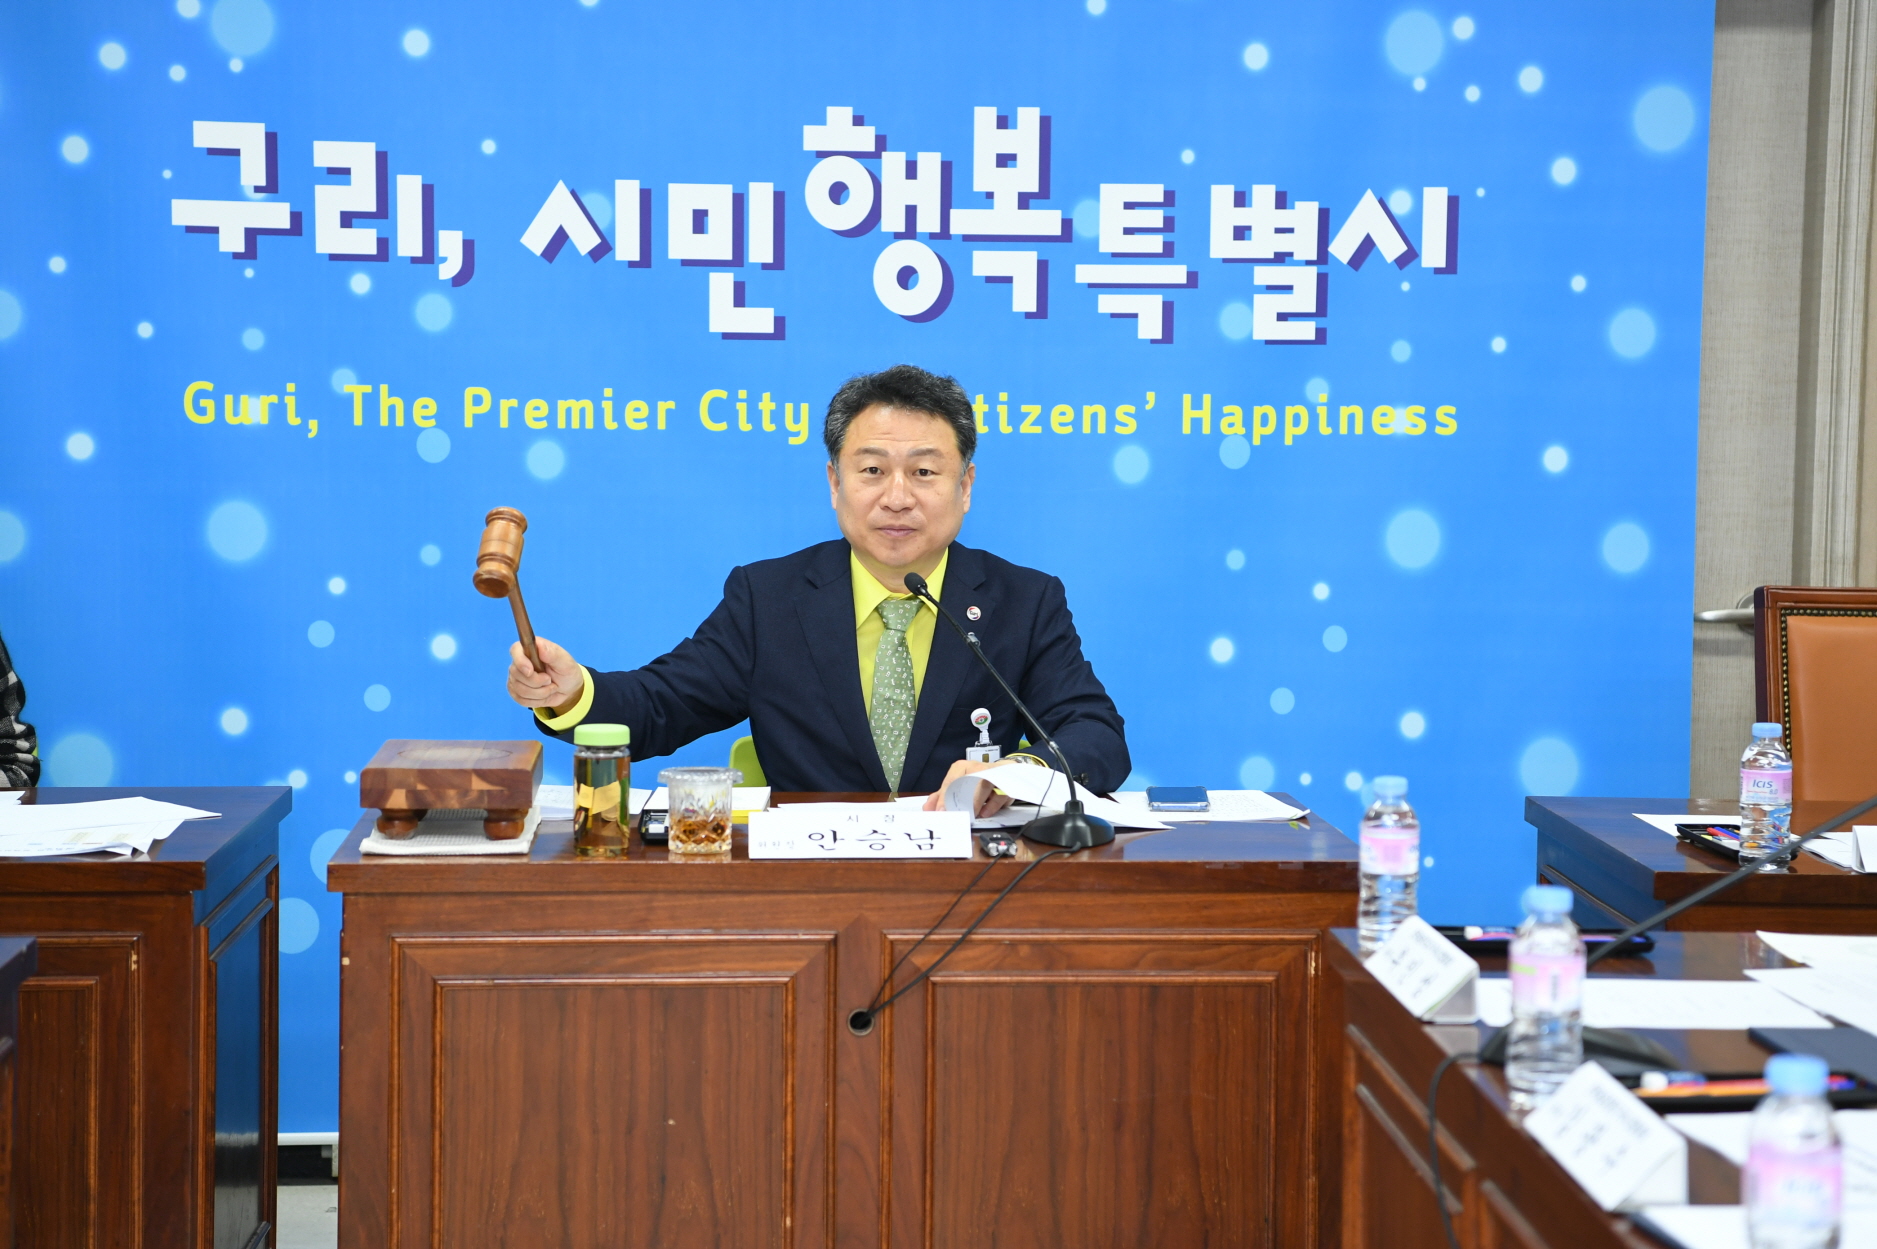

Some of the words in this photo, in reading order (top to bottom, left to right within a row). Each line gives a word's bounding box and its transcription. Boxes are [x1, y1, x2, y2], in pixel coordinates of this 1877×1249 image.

[172, 120, 474, 287] 구리,
[183, 380, 318, 438] Guri,
[343, 383, 438, 428] The
[464, 386, 676, 430] Premier
[699, 388, 809, 445] City
[972, 391, 1155, 435] tizens’
[1182, 393, 1458, 446] Happiness
[808, 829, 941, 851] 안승남
